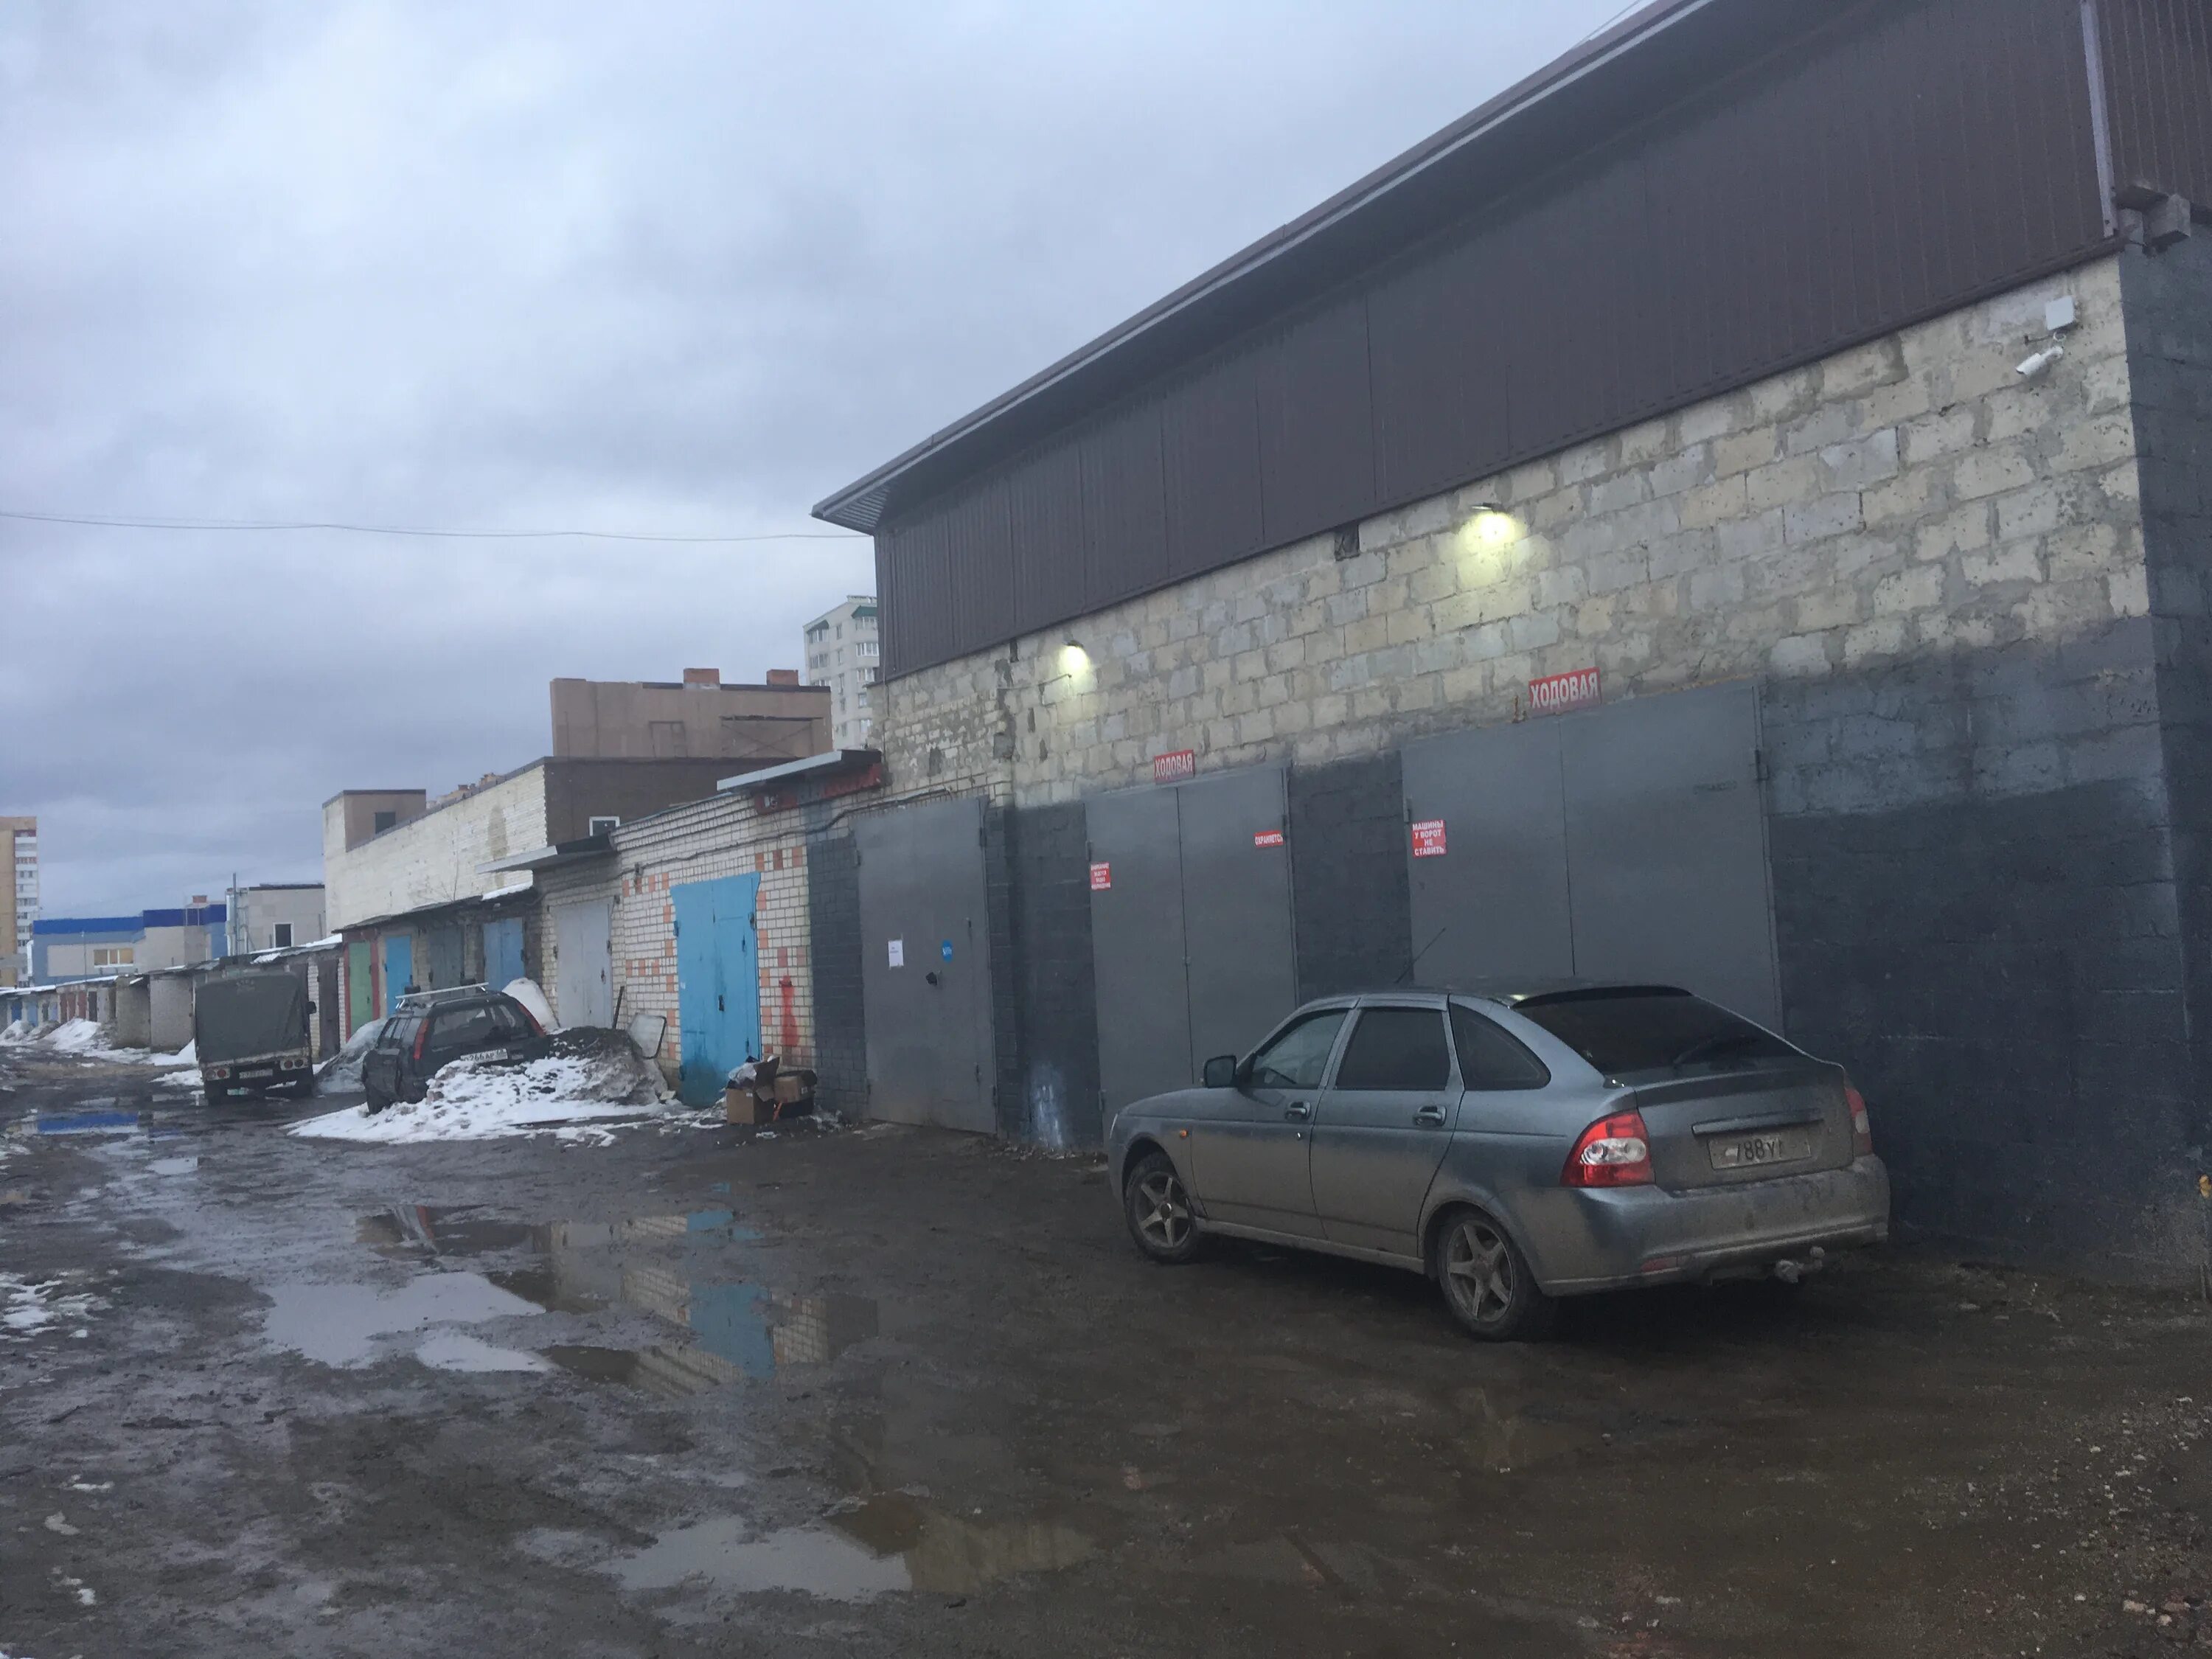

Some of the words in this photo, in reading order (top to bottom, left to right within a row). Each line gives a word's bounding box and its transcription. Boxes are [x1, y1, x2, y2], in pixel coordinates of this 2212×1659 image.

[1530, 672, 1598, 709] ХОДОВАЯ
[1155, 753, 1193, 779] ХОДОВАЯ
[1413, 820, 1443, 831] МАШИНЫ
[1415, 831, 1419, 839] У
[1420, 830, 1441, 838] ВОРОТ
[1424, 838, 1433, 846] НЕ
[1415, 846, 1444, 856] СТАВИТЬ
